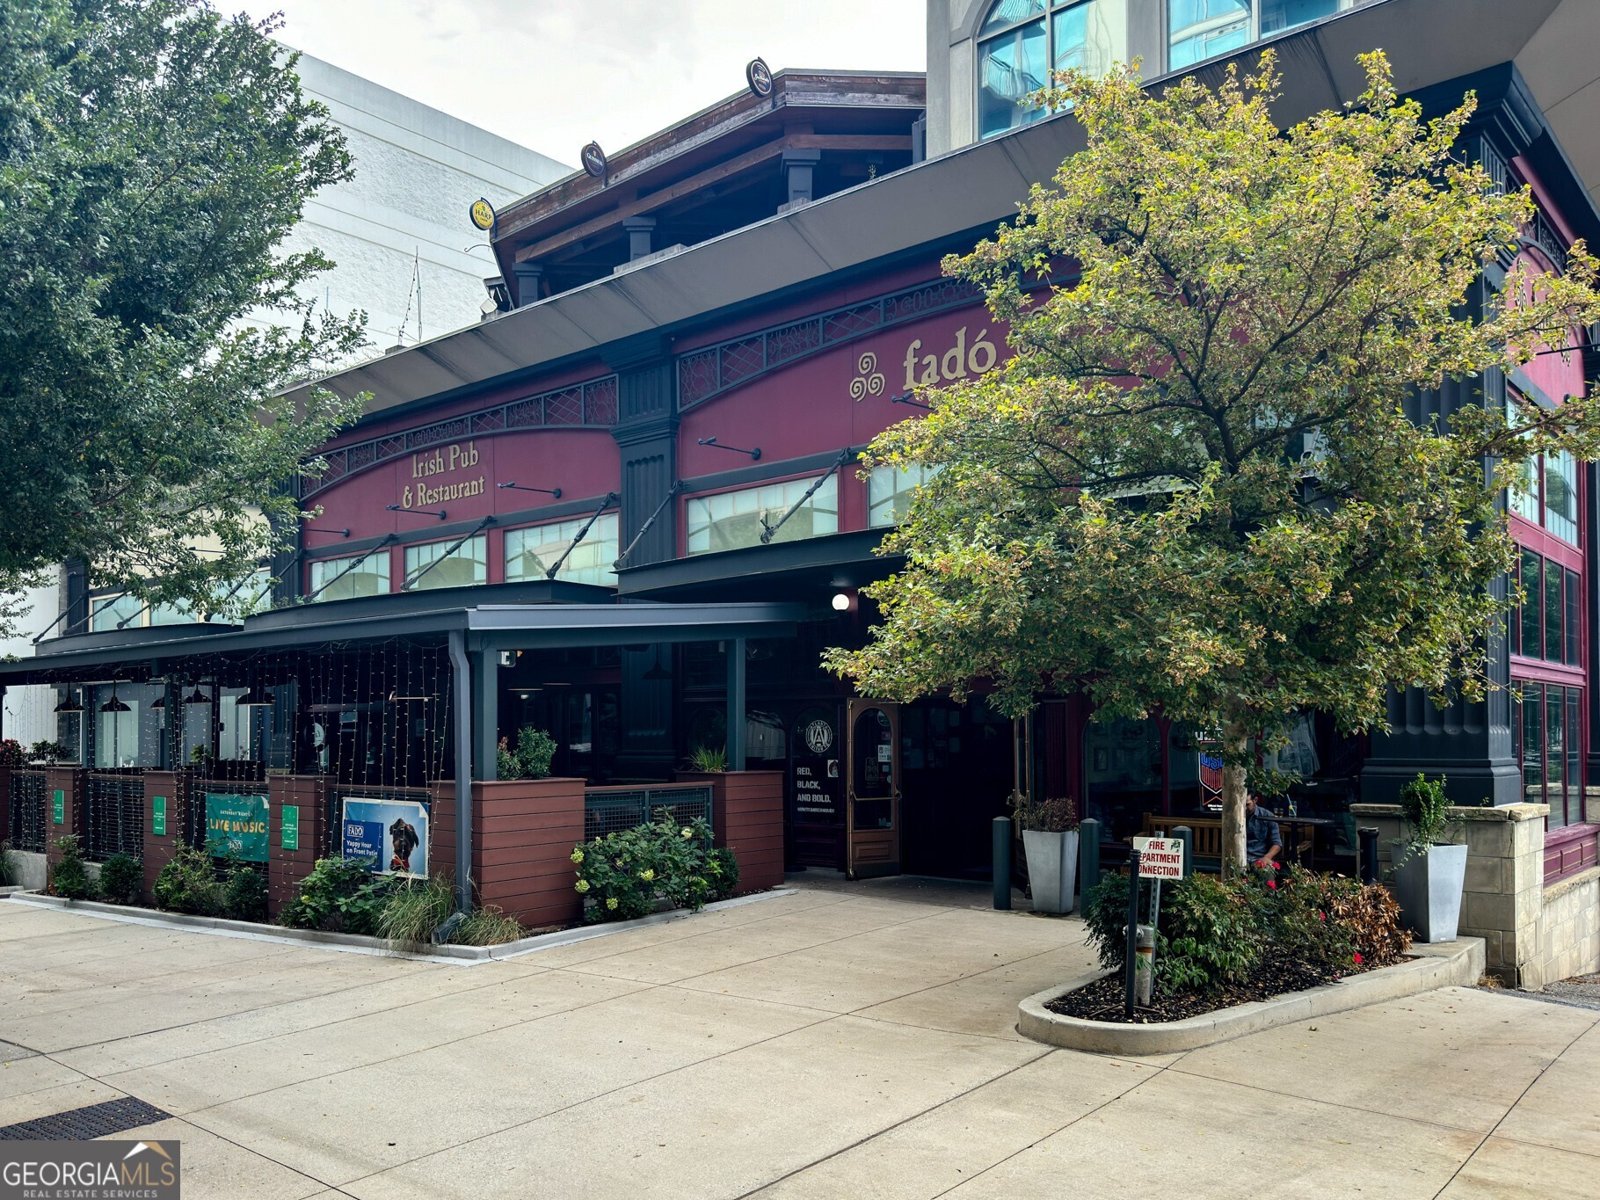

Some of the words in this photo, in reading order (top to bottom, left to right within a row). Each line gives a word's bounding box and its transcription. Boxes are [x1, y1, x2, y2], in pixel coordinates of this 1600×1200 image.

[903, 326, 997, 390] fadó
[412, 448, 445, 478] Irish
[449, 441, 479, 471] Pub
[402, 485, 413, 509] &
[417, 476, 485, 507] Restaurant
[797, 767, 812, 776] RED,
[797, 781, 821, 790] BLACK,
[797, 794, 811, 802] AND
[812, 795, 832, 803] BOLD.
[210, 818, 230, 832] LIVE
[232, 821, 265, 834] MUSIC
[346, 840, 361, 848] Yappy
[361, 841, 372, 849] Hour
[1148, 841, 1165, 850] FIRE
[1139, 853, 1180, 864] EPARTMENT
[1139, 865, 1180, 876] ONNECTION
